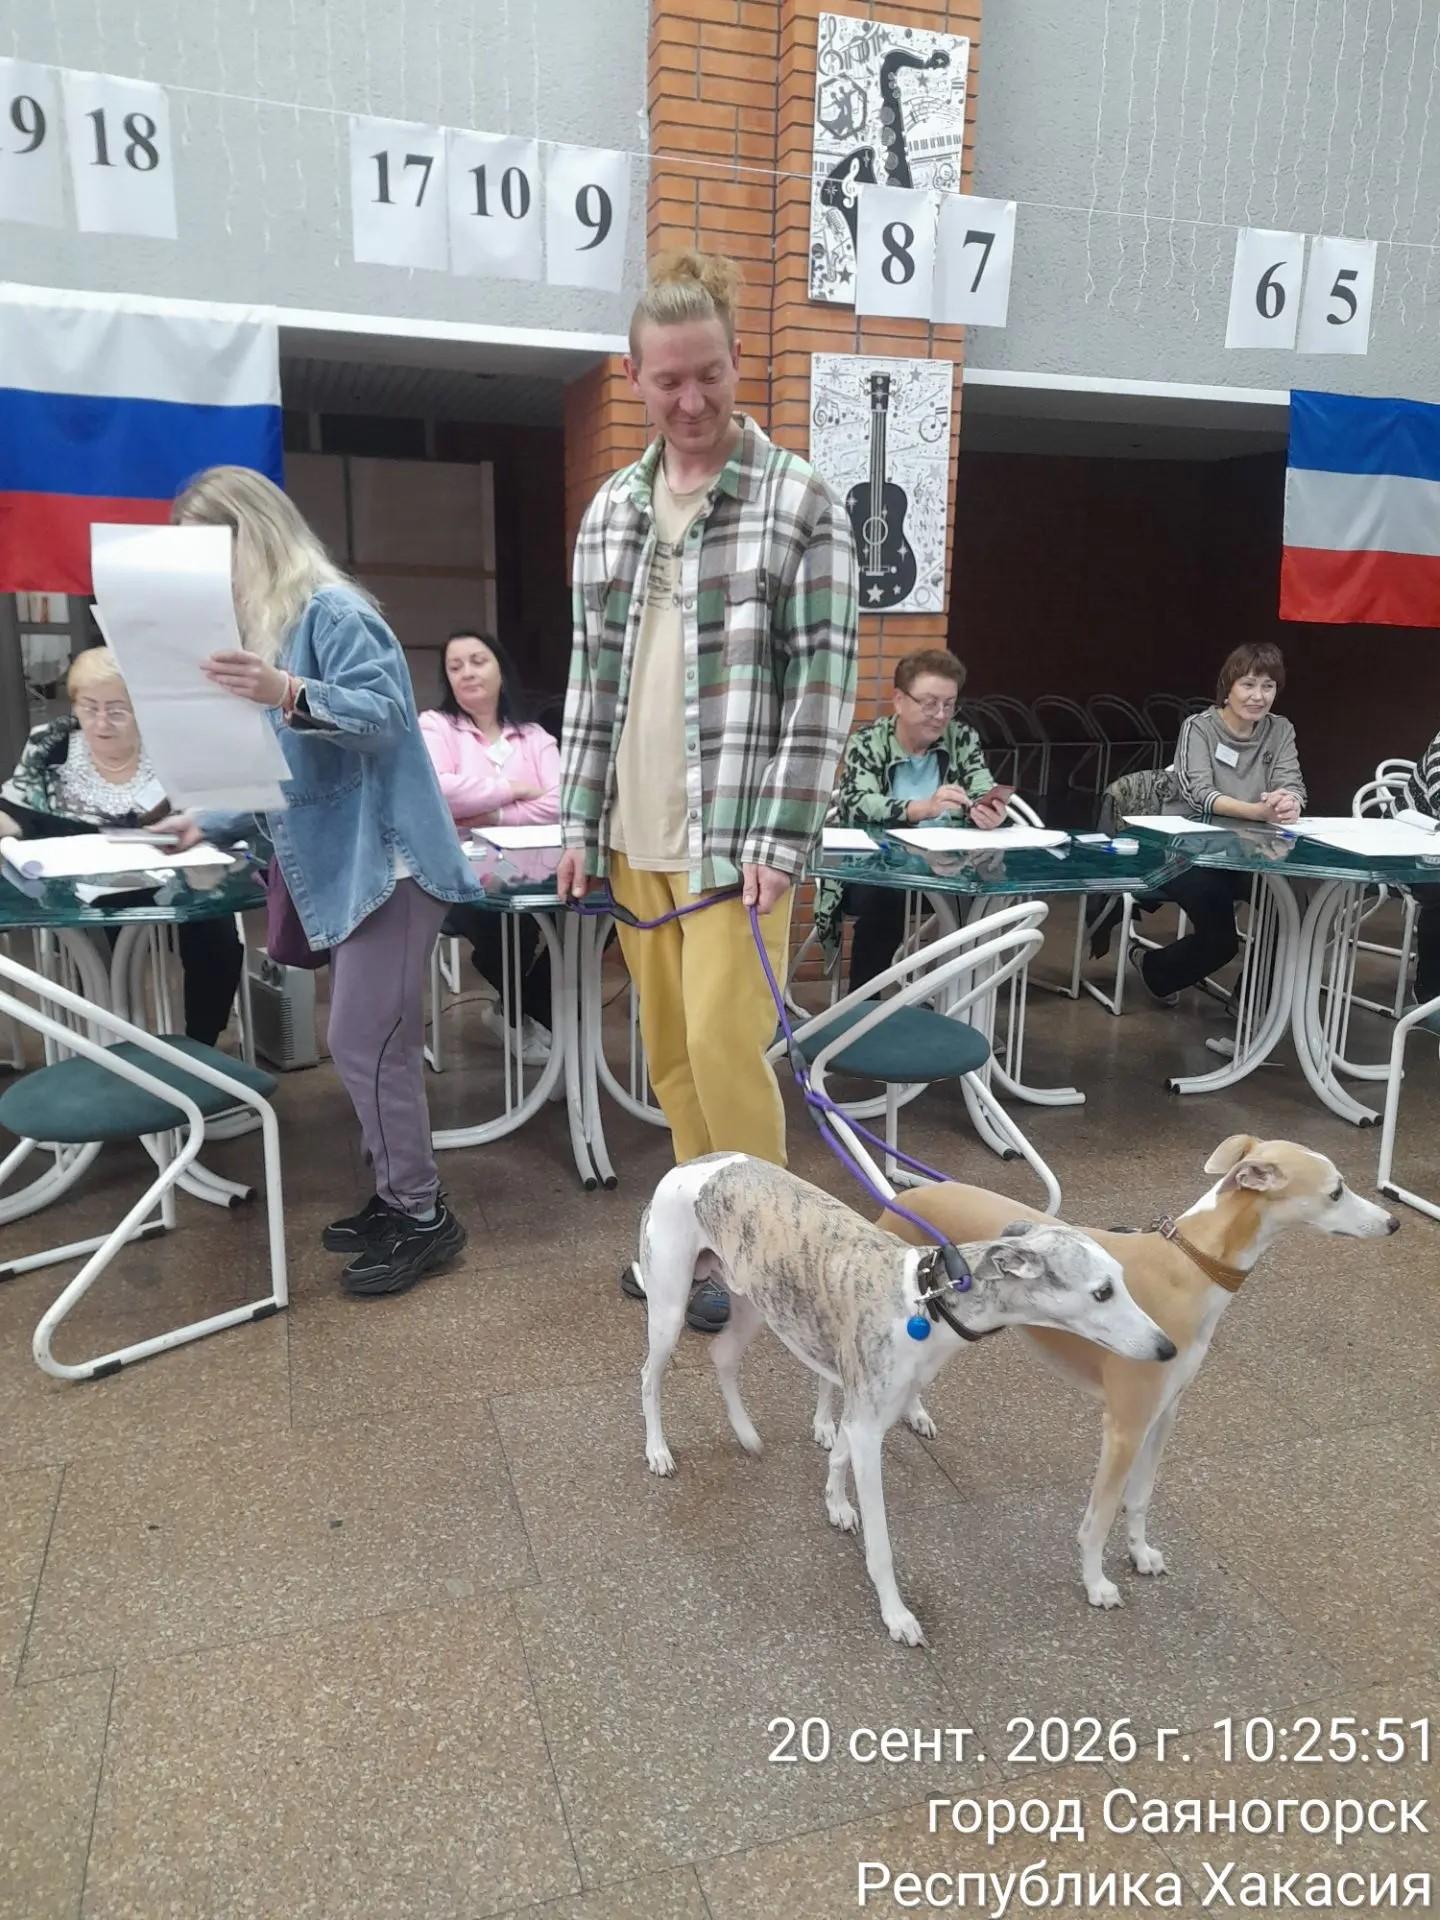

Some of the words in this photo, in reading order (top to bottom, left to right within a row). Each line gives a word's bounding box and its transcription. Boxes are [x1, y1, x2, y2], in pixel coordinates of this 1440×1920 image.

[0, 94, 47, 155] 9
[86, 107, 160, 172] 18
[370, 149, 435, 208] 17
[468, 164, 531, 220] 10
[574, 183, 613, 252] 9
[880, 220, 916, 286] 8
[961, 228, 996, 294] 7
[1255, 261, 1288, 321] 6
[1325, 268, 1359, 326] 5
